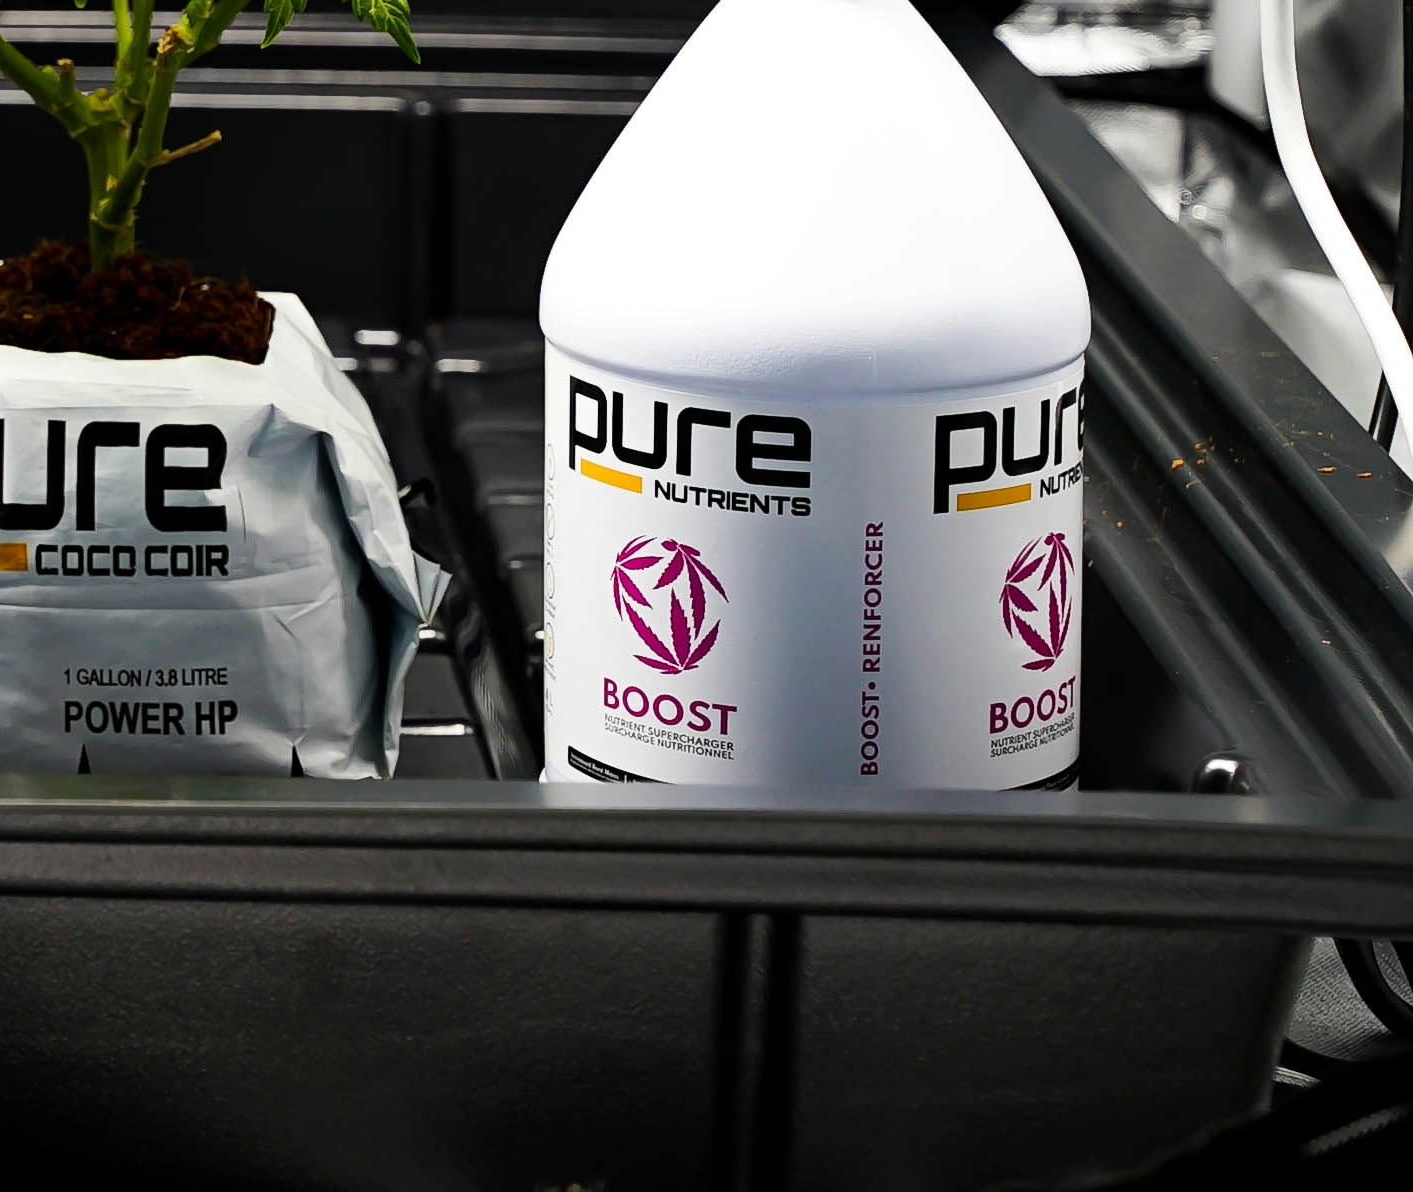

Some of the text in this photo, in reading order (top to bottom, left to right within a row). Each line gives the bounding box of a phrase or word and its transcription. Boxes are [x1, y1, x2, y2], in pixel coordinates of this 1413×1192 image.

[569, 375, 812, 489] pure
[654, 479, 812, 517] NUTRIENTS
[35, 543, 230, 577] COCO COIR
[862, 521, 884, 673] RENFORCER
[64, 668, 71, 685] 1
[76, 667, 142, 687] GALLON
[155, 668, 178, 687] 3.8
[181, 667, 228, 686] LITRE
[64, 699, 239, 736] POWER HP
[603, 677, 738, 736] BOOST
[989, 675, 1076, 734] BOOST
[604, 712, 734, 751] NUTRIENT SUPERCHARGER
[604, 722, 735, 760] SURCHARGE NUTRITIONNEL
[990, 730, 1032, 748] NUTRIENT
[990, 739, 1038, 758] SURCHARGE
